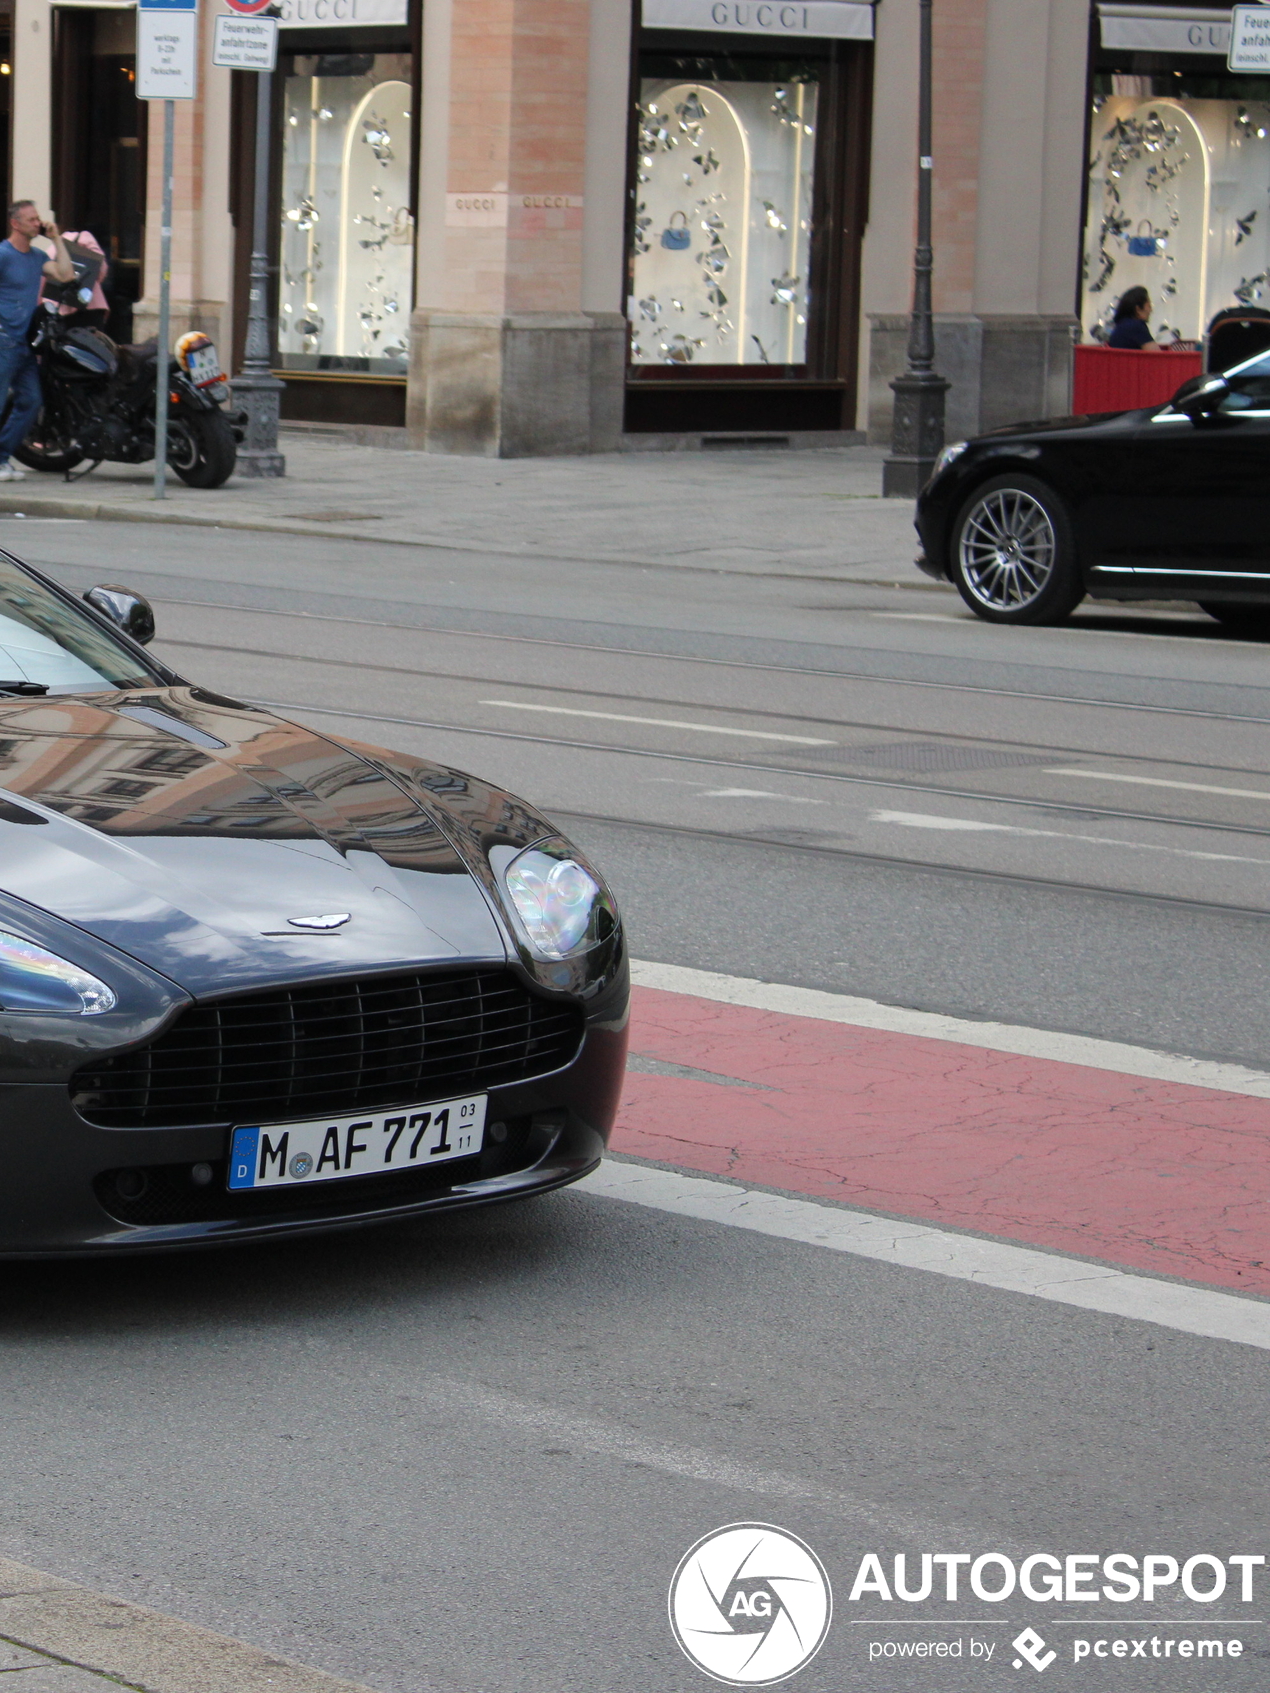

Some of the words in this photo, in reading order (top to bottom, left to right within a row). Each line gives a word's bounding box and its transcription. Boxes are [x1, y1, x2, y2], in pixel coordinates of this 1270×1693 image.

[279, 0, 357, 21] GUCCI
[711, 2, 808, 29] GUCCI
[223, 21, 269, 35] Feuerwehr-
[1187, 24, 1230, 46] GU
[220, 37, 268, 51] anfahrtzone
[455, 199, 495, 210] GUCCI
[461, 1103, 476, 1117] 03
[237, 1164, 248, 1178] D
[259, 1131, 289, 1179] M
[315, 1121, 373, 1173] AF
[383, 1108, 452, 1163] 771
[459, 1135, 471, 1149] 11
